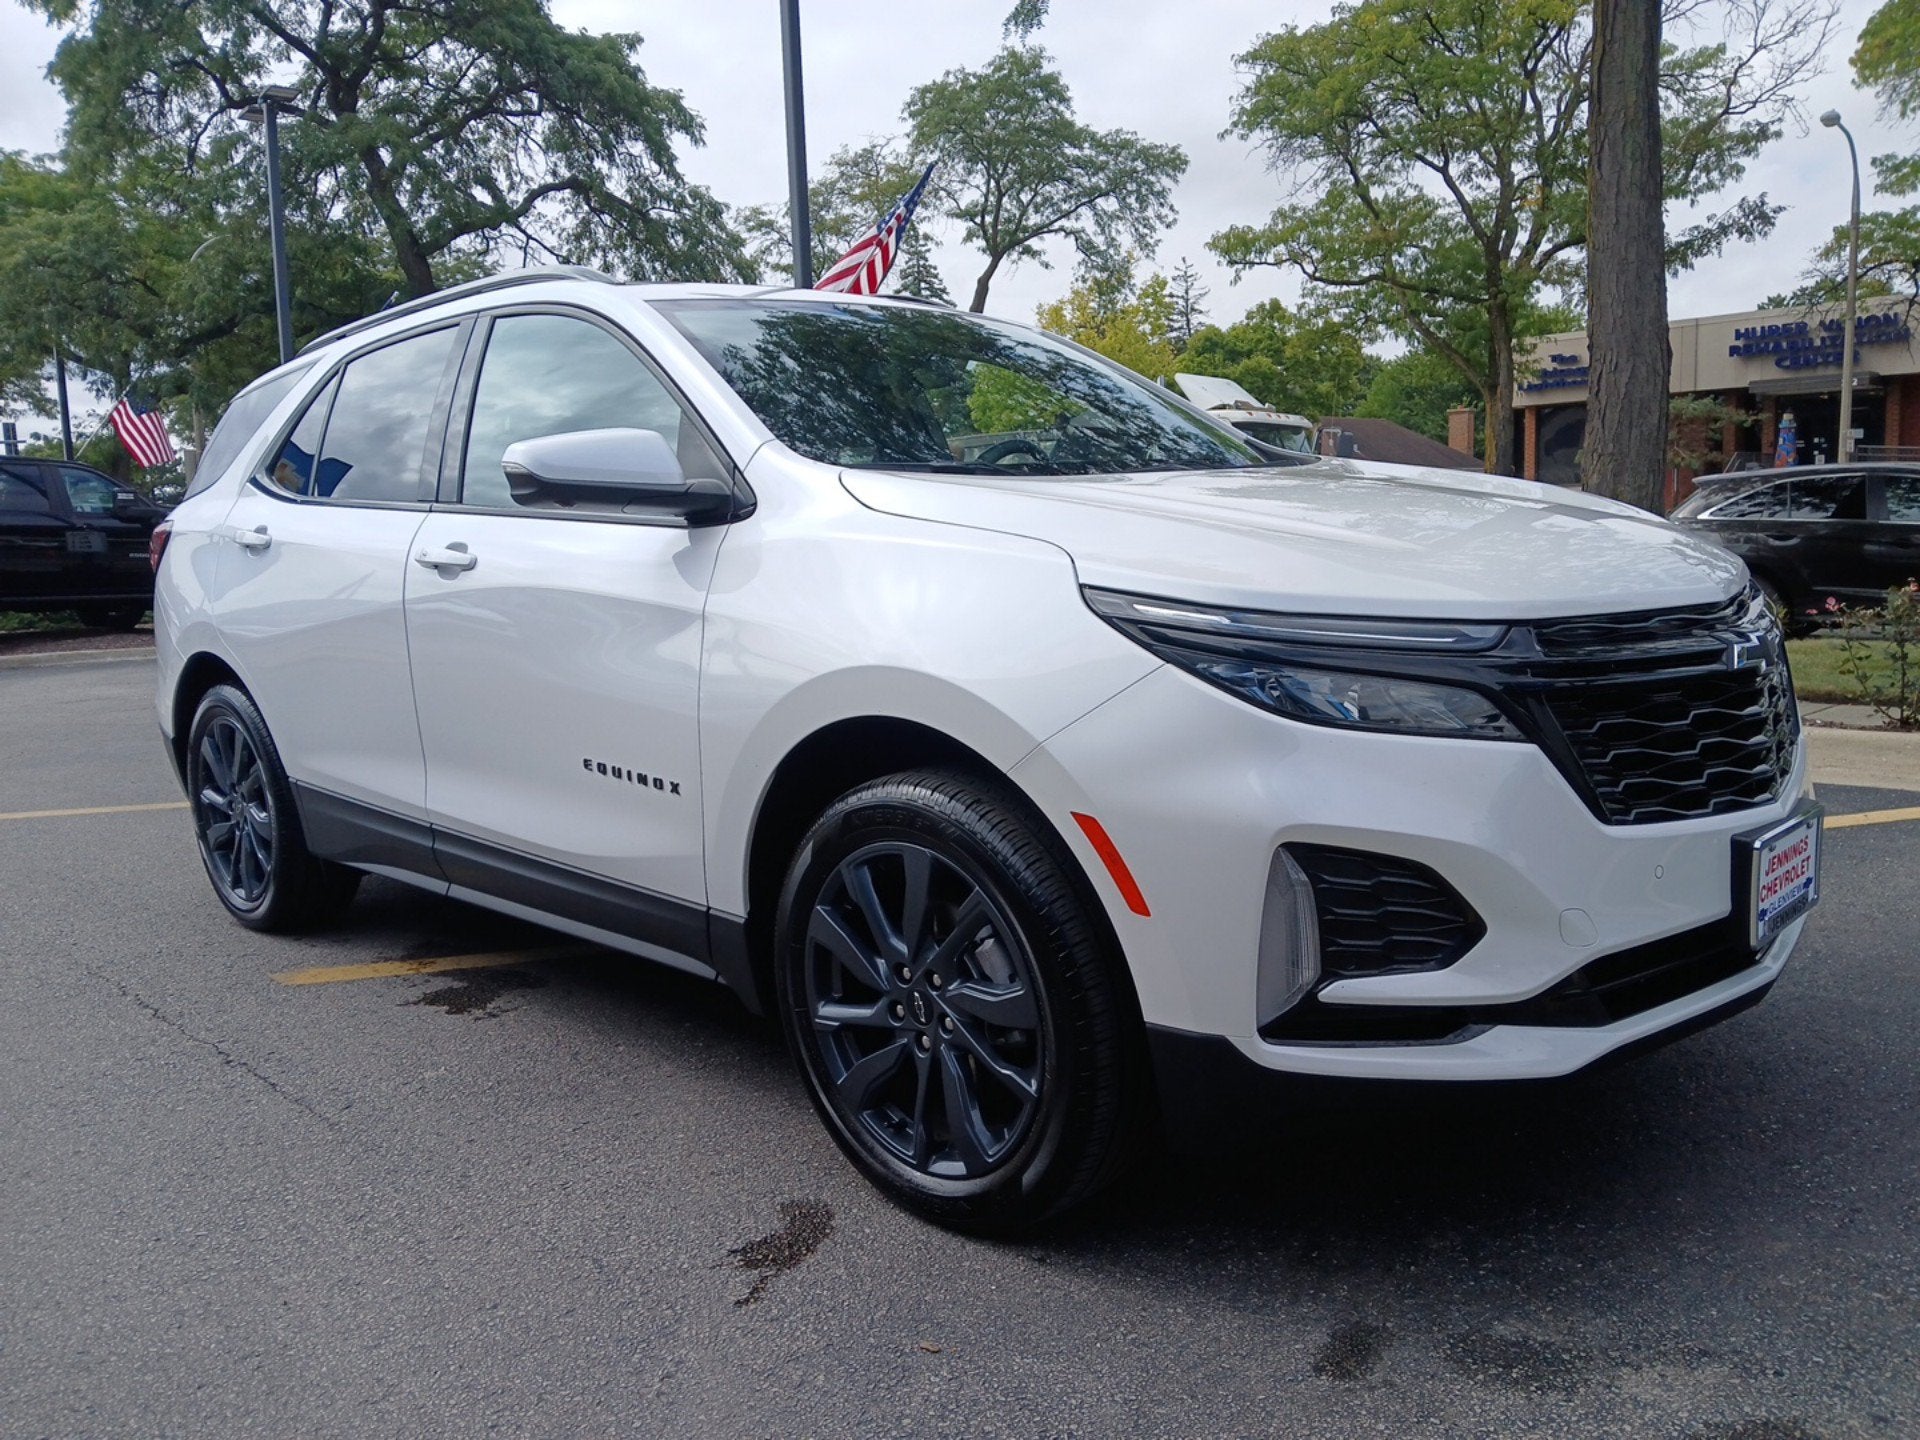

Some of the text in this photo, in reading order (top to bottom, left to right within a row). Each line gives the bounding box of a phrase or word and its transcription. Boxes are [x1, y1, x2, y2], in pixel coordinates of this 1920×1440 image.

[1819, 312, 1899, 332] VIION
[583, 758, 681, 796] EQUINOX
[1765, 835, 1809, 877] JENNINGS
[1760, 855, 1811, 903] CHEVROLET
[1768, 884, 1804, 914] GLENVIEW
[1770, 895, 1809, 933] JENNINGS
